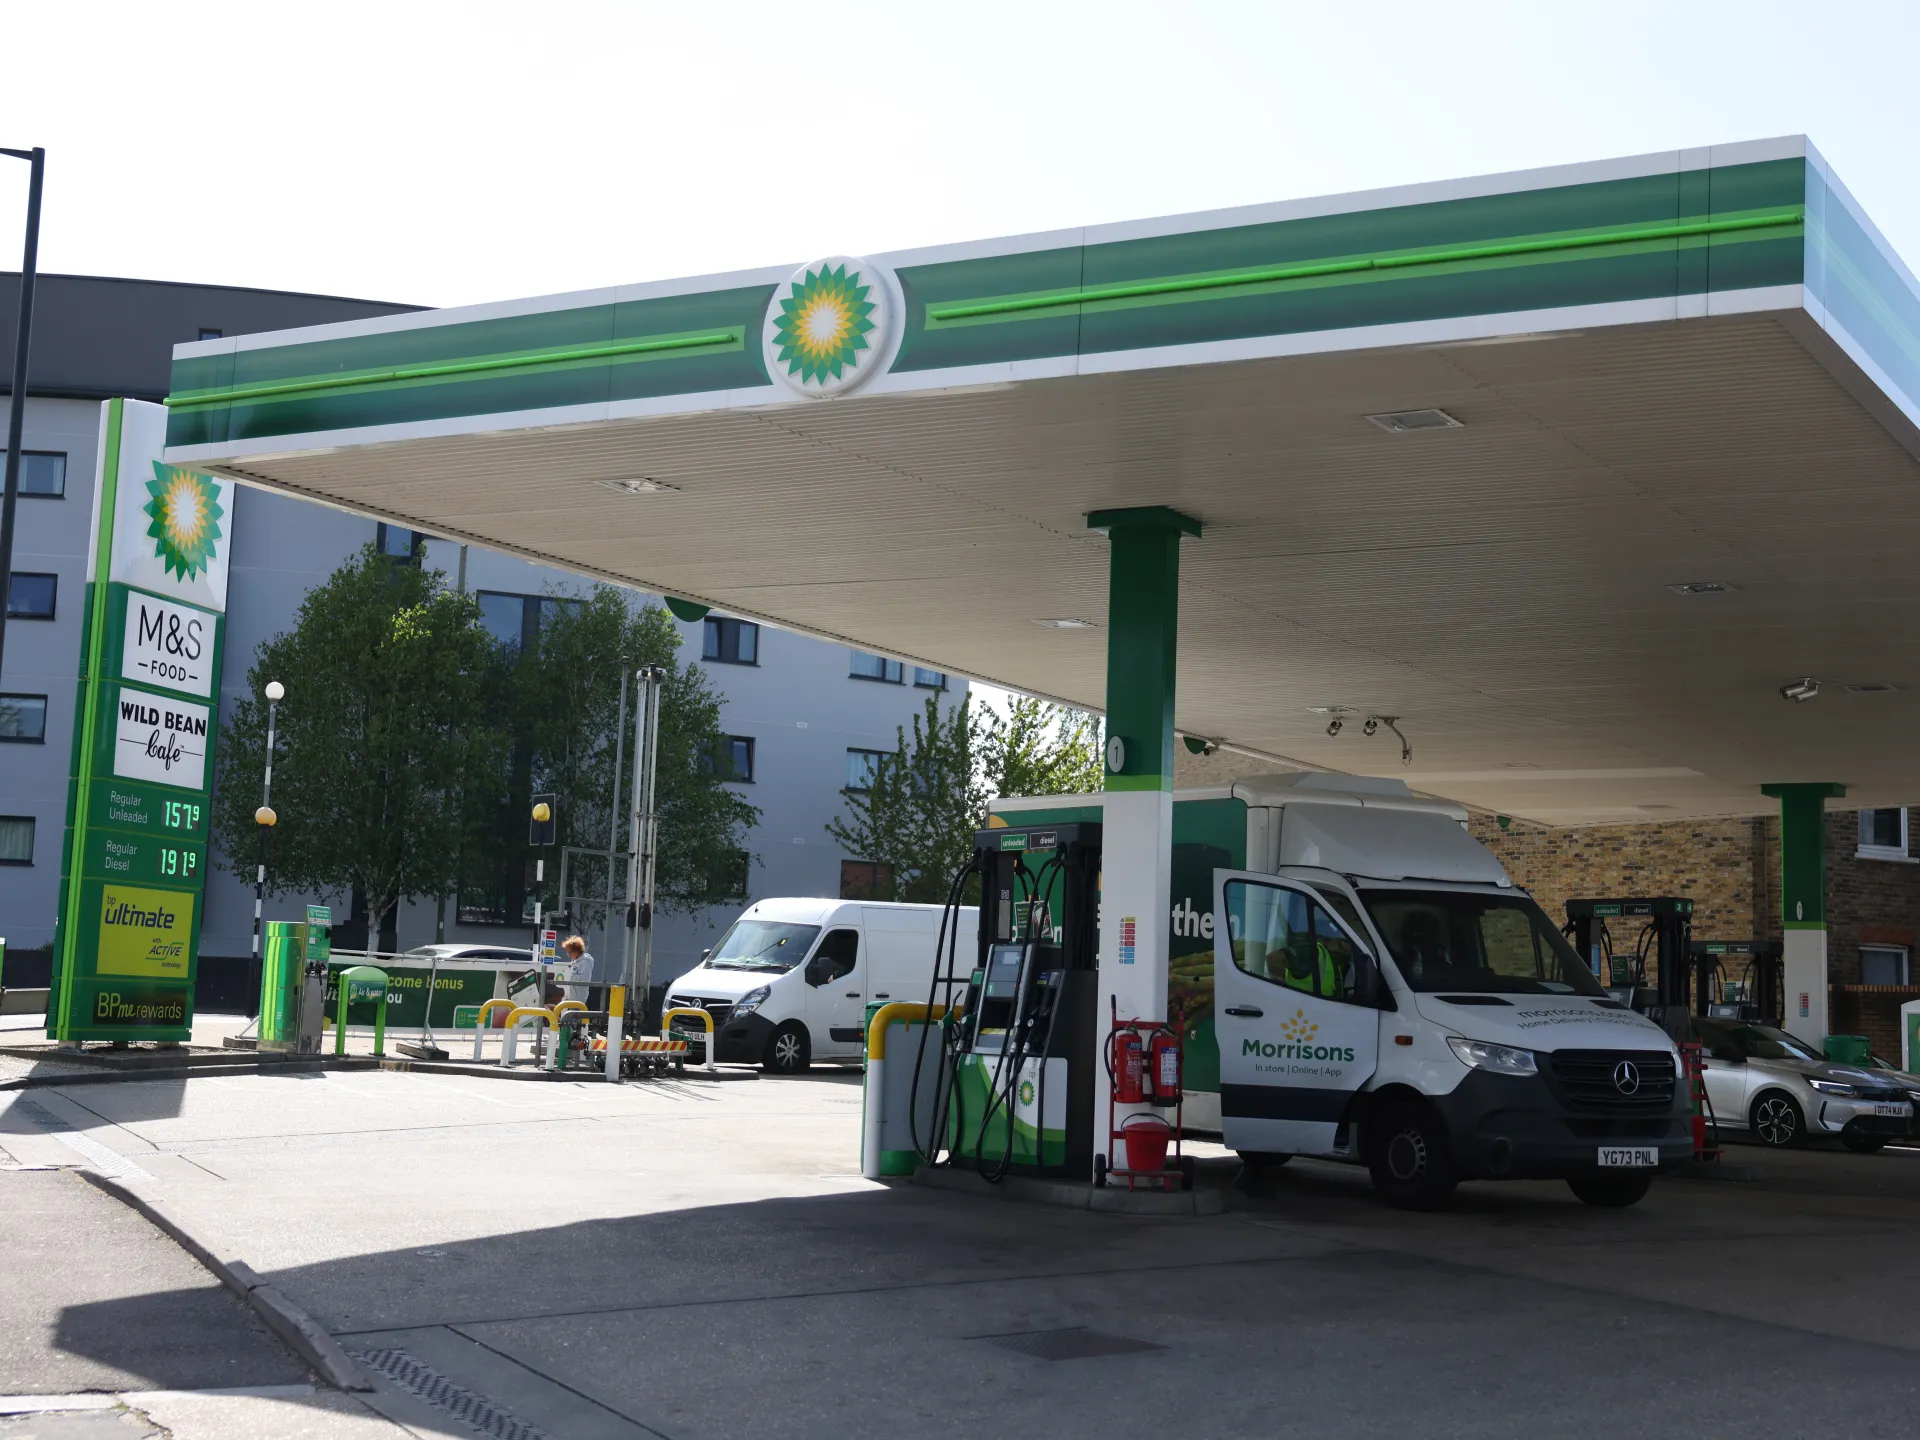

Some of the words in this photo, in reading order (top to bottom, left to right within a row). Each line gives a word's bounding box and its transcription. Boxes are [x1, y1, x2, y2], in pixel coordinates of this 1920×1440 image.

[138, 604, 203, 661] M&S
[151, 660, 187, 681] FOOD
[120, 701, 160, 726] WILD
[164, 711, 207, 737] BEAN
[110, 790, 142, 807] Regular
[109, 806, 148, 824] Unleaded
[1002, 838, 1026, 847] unleaded
[1039, 835, 1055, 845] diesel
[106, 840, 138, 856] Regular
[105, 856, 130, 871] Diesel
[106, 894, 116, 906] bp
[104, 903, 175, 929] ultimate
[148, 945, 182, 957] ACTIVE
[357, 987, 366, 996] Air
[136, 1002, 182, 1019] rewards
[1517, 1018, 1551, 1030] Home
[1241, 1038, 1355, 1062] Morrisons
[1255, 1063, 1263, 1072] In
[1265, 1064, 1285, 1073] store
[1291, 1065, 1318, 1075] Online
[1324, 1067, 1342, 1078] App
[1603, 1150, 1632, 1165] YG73
[1635, 1150, 1655, 1165] PNL
